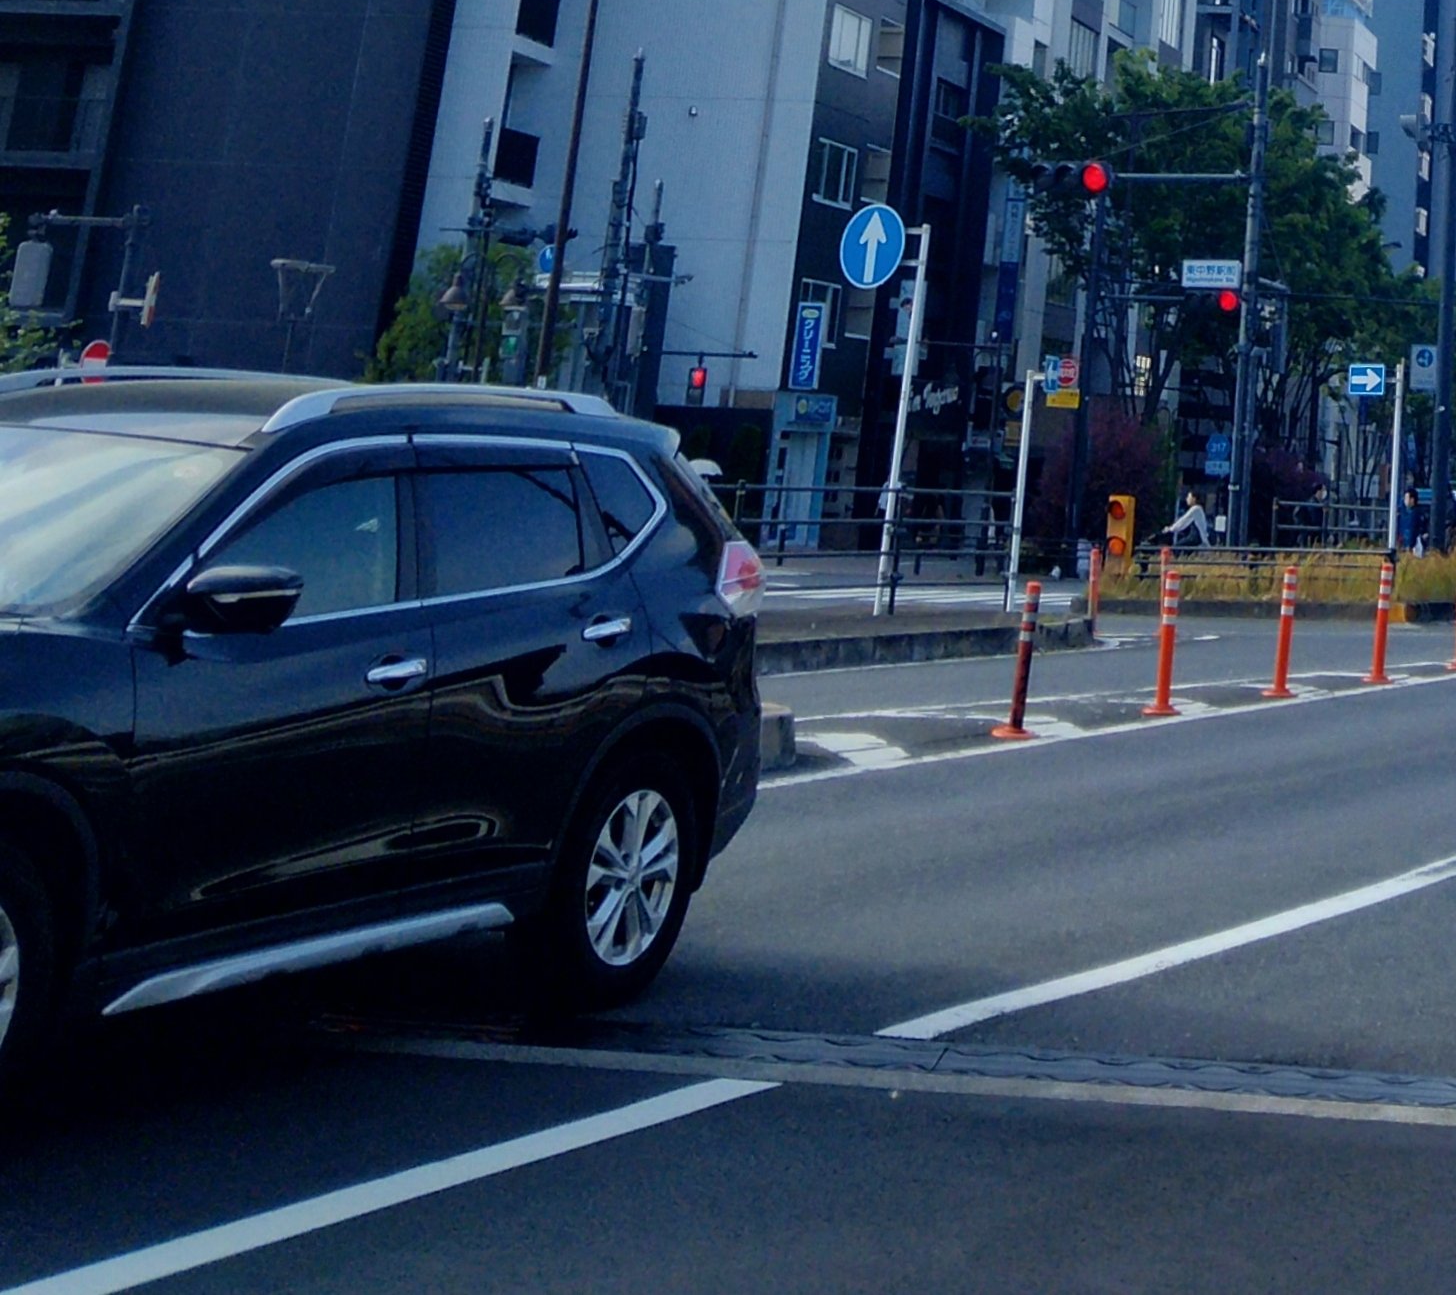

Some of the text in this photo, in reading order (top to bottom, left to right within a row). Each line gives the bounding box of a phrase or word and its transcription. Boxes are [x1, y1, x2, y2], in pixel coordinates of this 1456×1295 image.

[798, 318, 816, 381] クリーニング
[1210, 442, 1227, 453] 317
